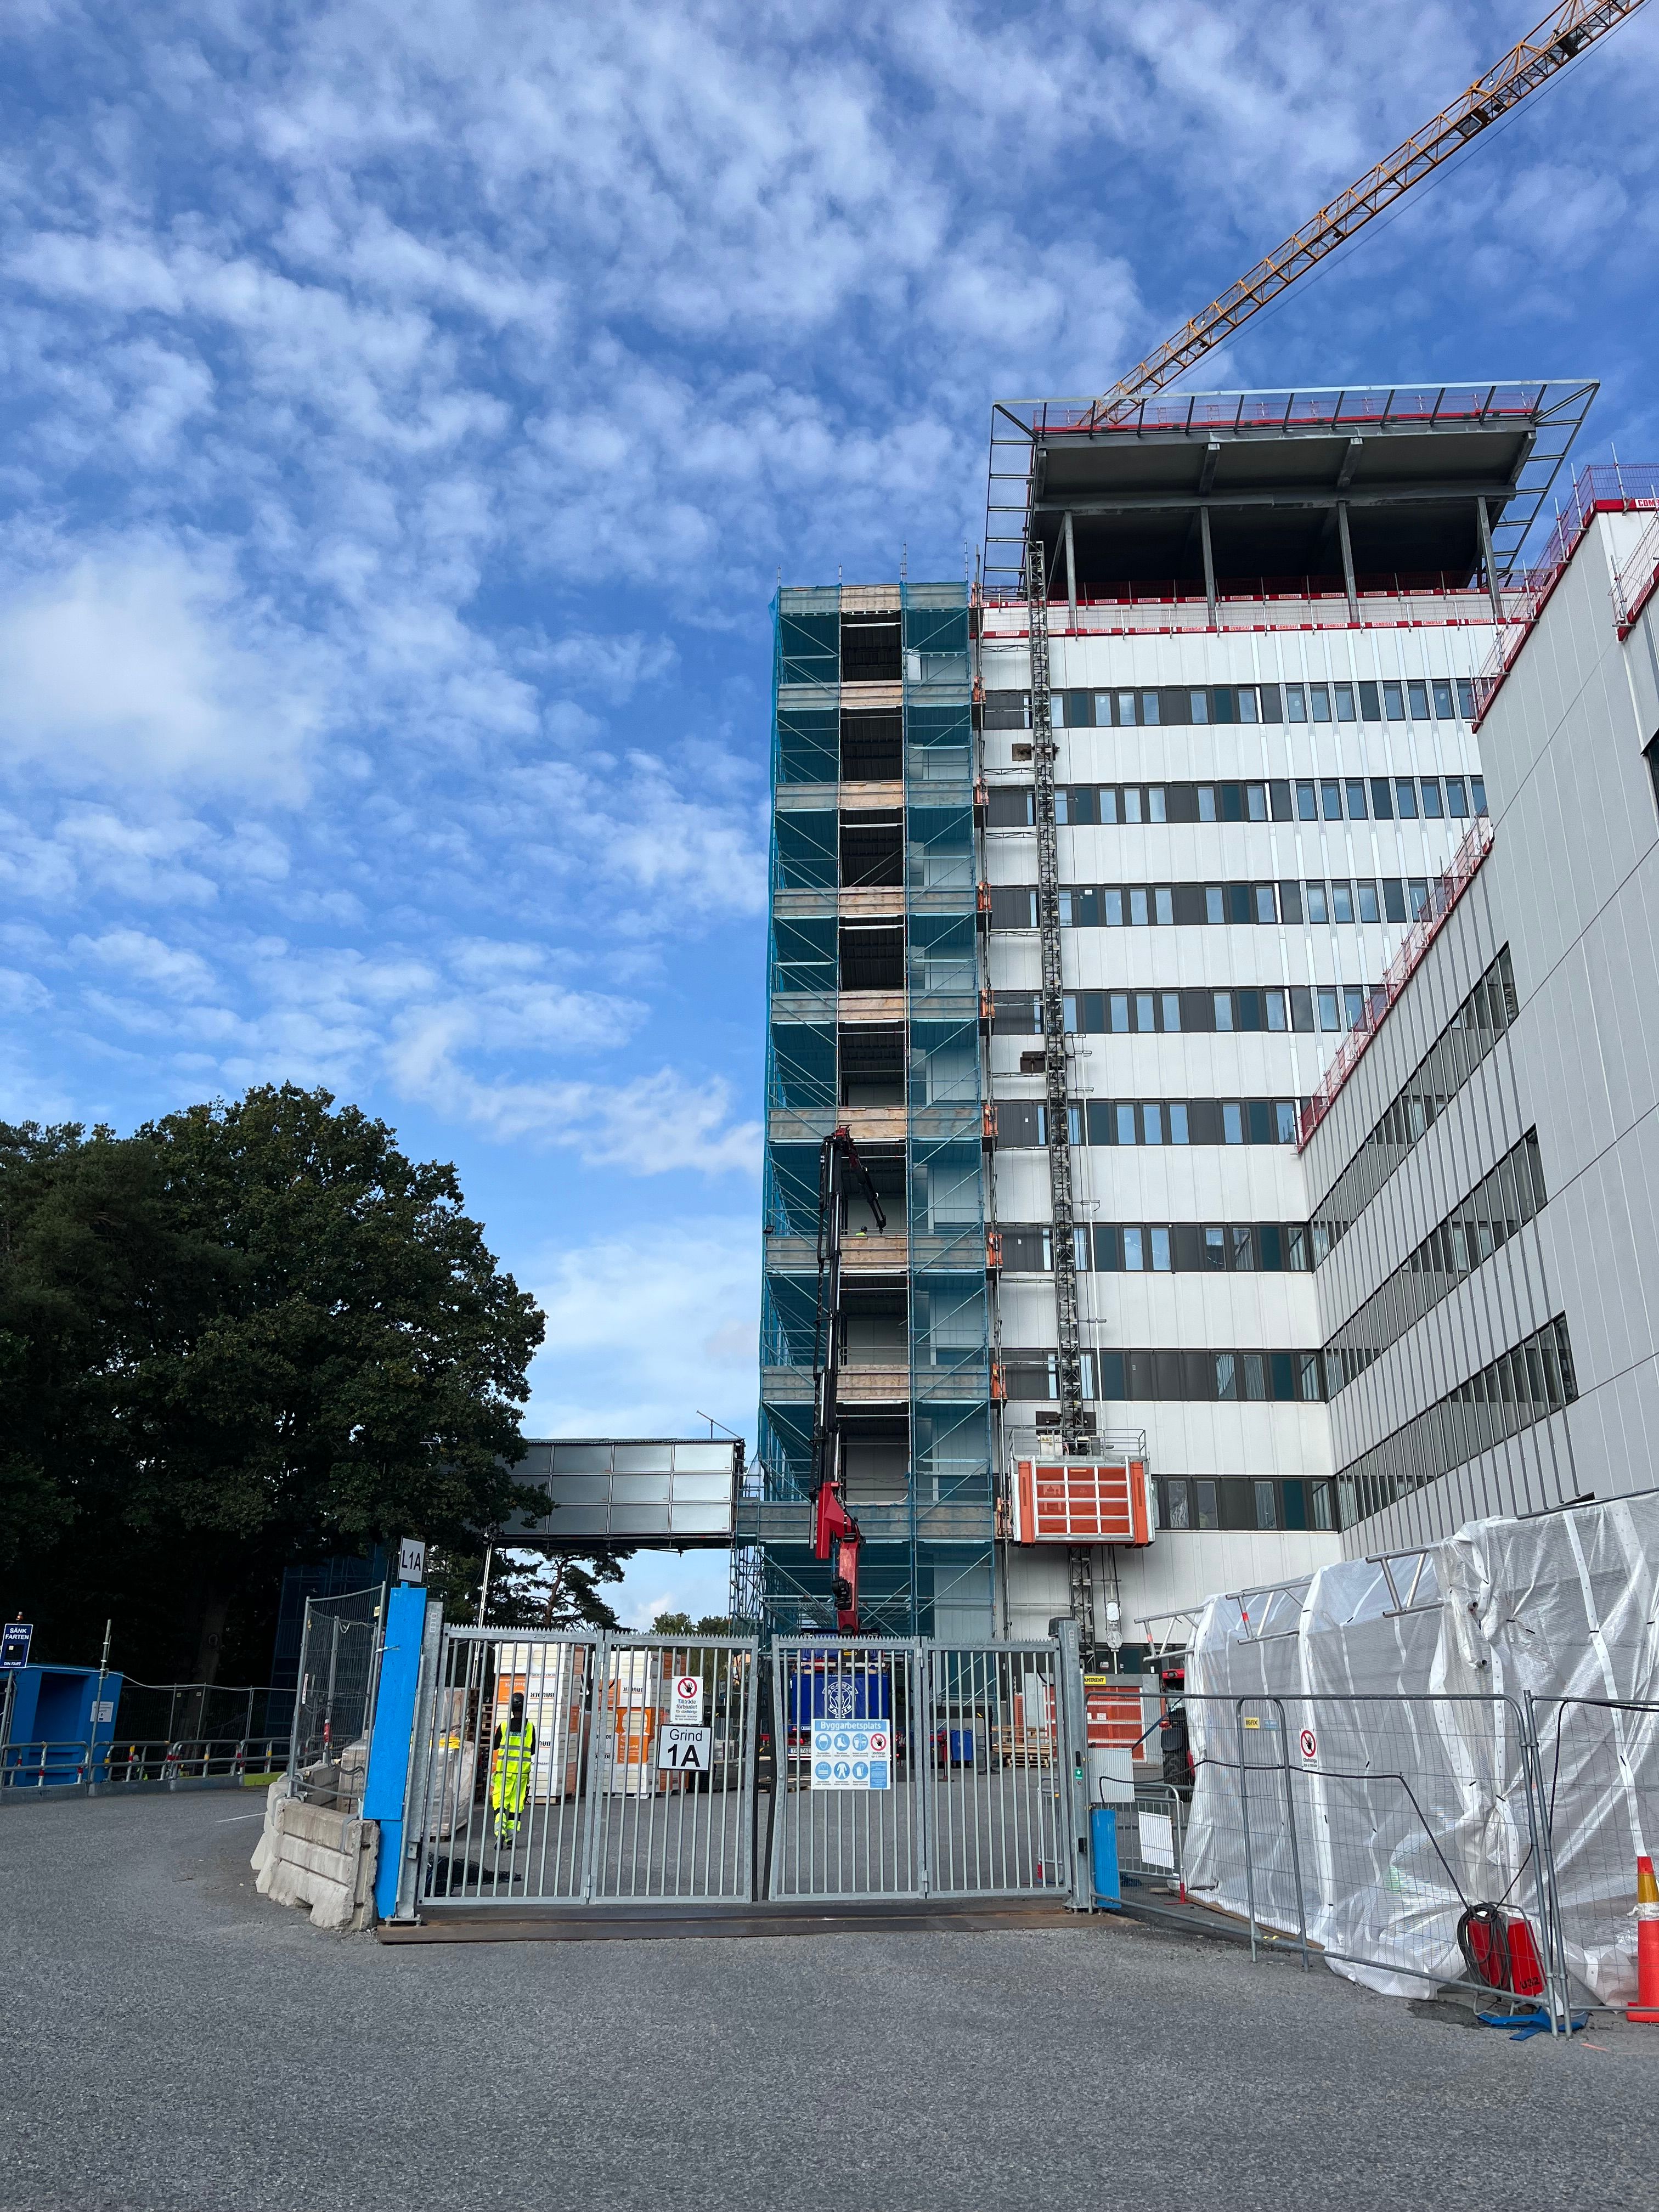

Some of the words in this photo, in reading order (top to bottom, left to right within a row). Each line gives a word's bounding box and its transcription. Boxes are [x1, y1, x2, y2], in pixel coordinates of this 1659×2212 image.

[402, 1550, 421, 1571] L1A
[820, 1721, 881, 1730] Byggarbetsplats
[669, 1729, 702, 1741] Grind
[668, 1743, 701, 1767] 1A
